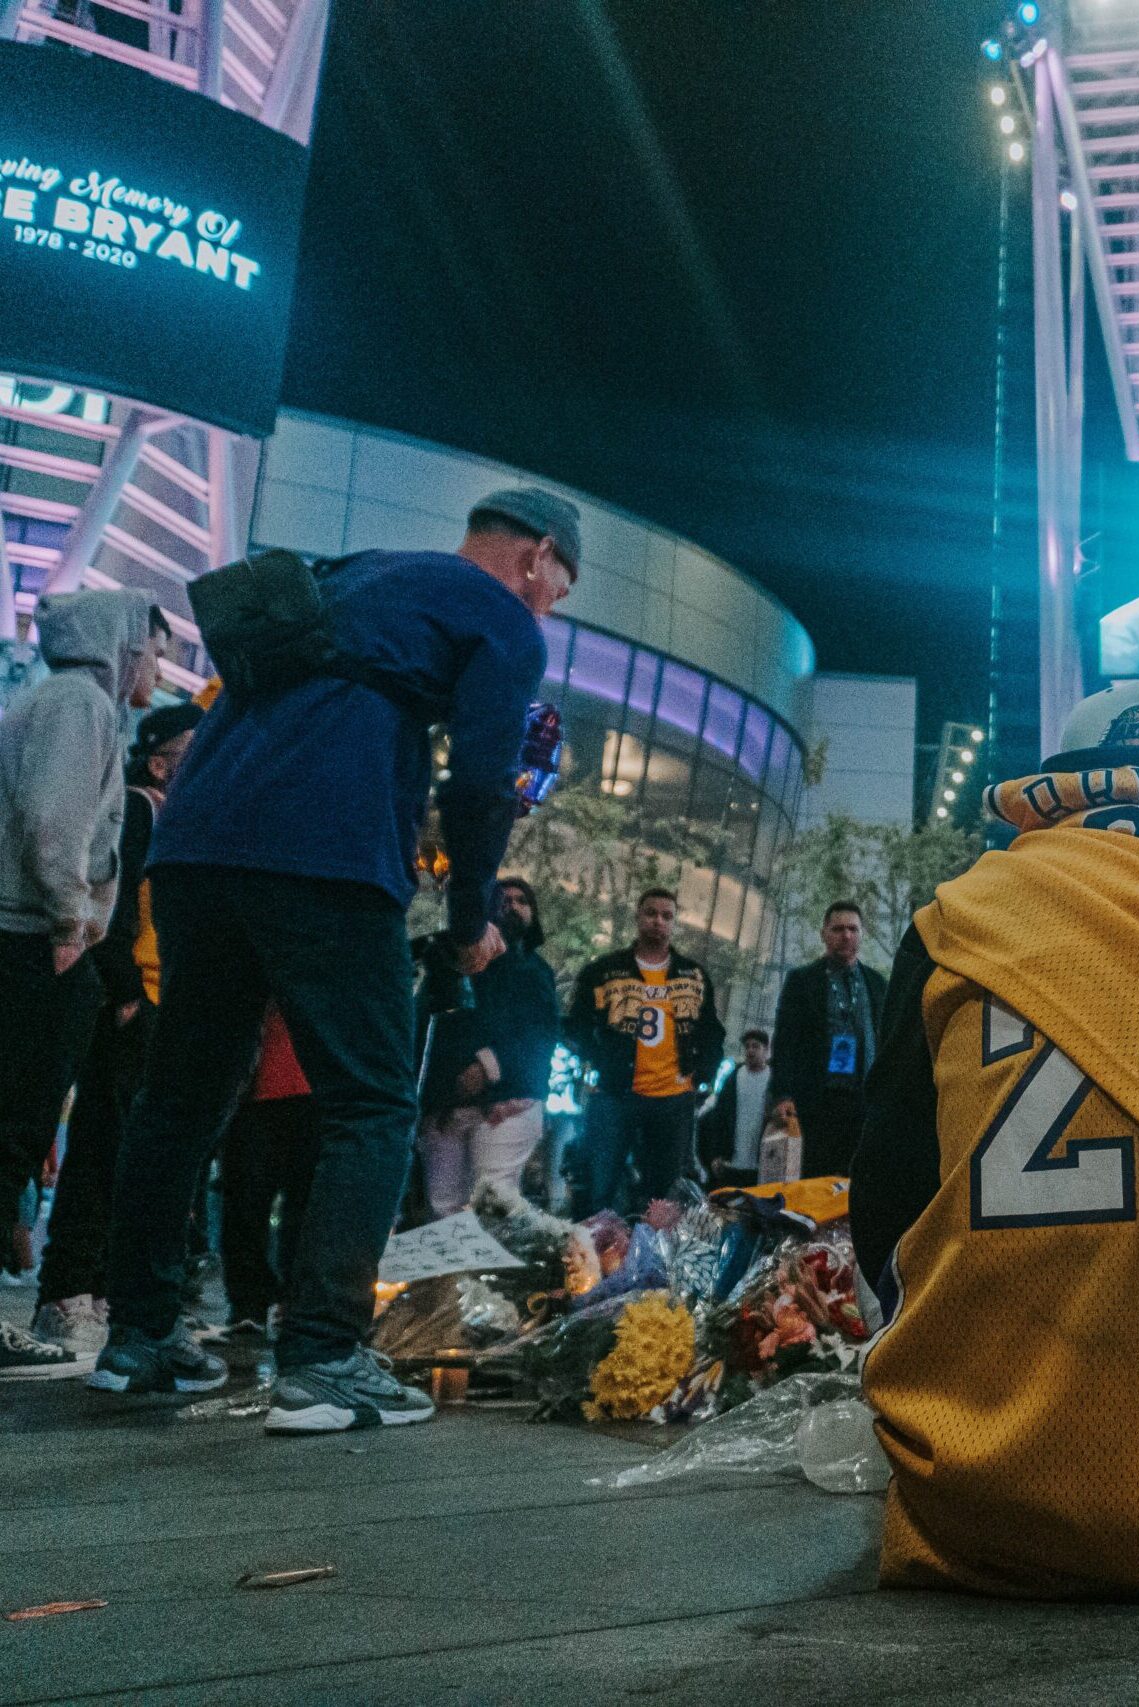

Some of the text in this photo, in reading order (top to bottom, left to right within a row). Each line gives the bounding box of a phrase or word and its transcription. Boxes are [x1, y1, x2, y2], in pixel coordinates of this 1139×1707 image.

[0, 157, 62, 192] ving
[69, 170, 192, 228] Memory
[0, 187, 261, 291] E BRYANT
[14, 224, 63, 251] 1978
[82, 240, 138, 270] 2020
[637, 1006, 666, 1048] 8
